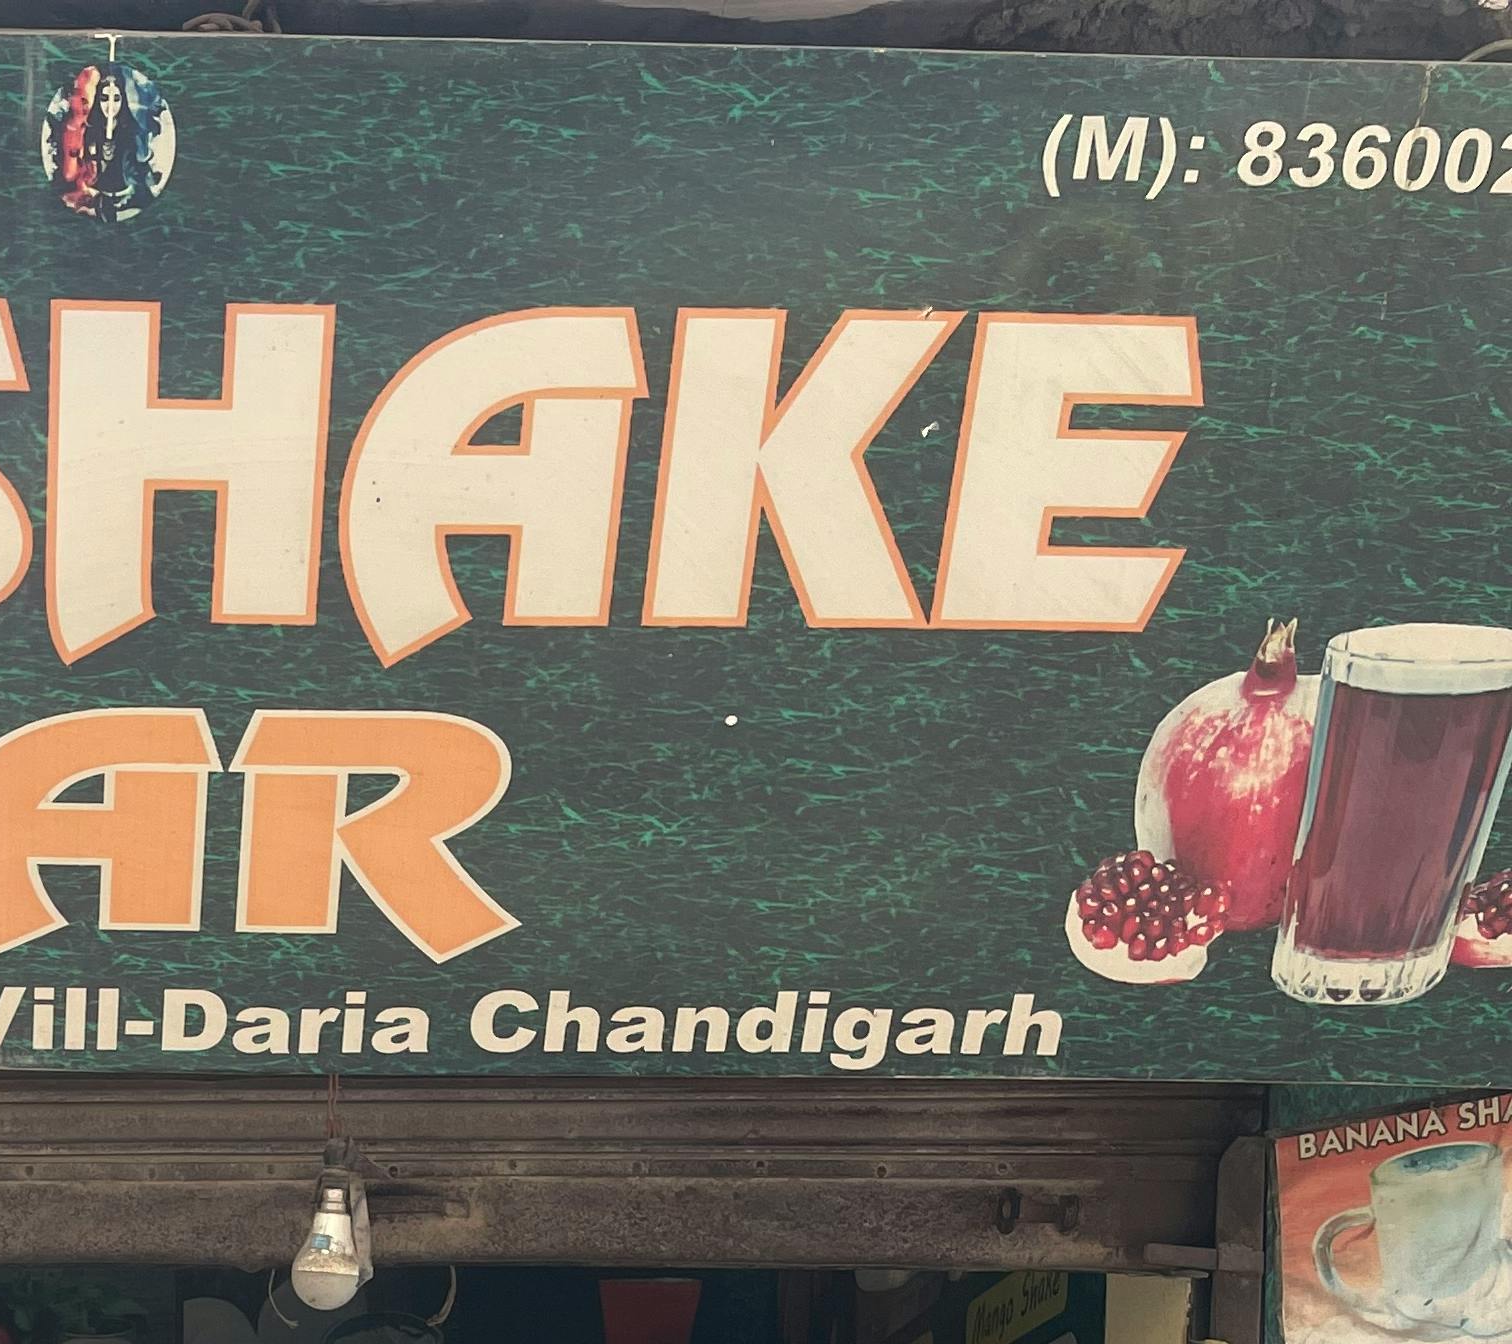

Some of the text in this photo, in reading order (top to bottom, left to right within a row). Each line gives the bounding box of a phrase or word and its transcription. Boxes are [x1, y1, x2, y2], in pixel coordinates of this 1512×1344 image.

[1042, 113, 1205, 200] (M):
[470, 989, 1064, 1070] Chandigarh
[1298, 1109, 1447, 1160] BANANA
